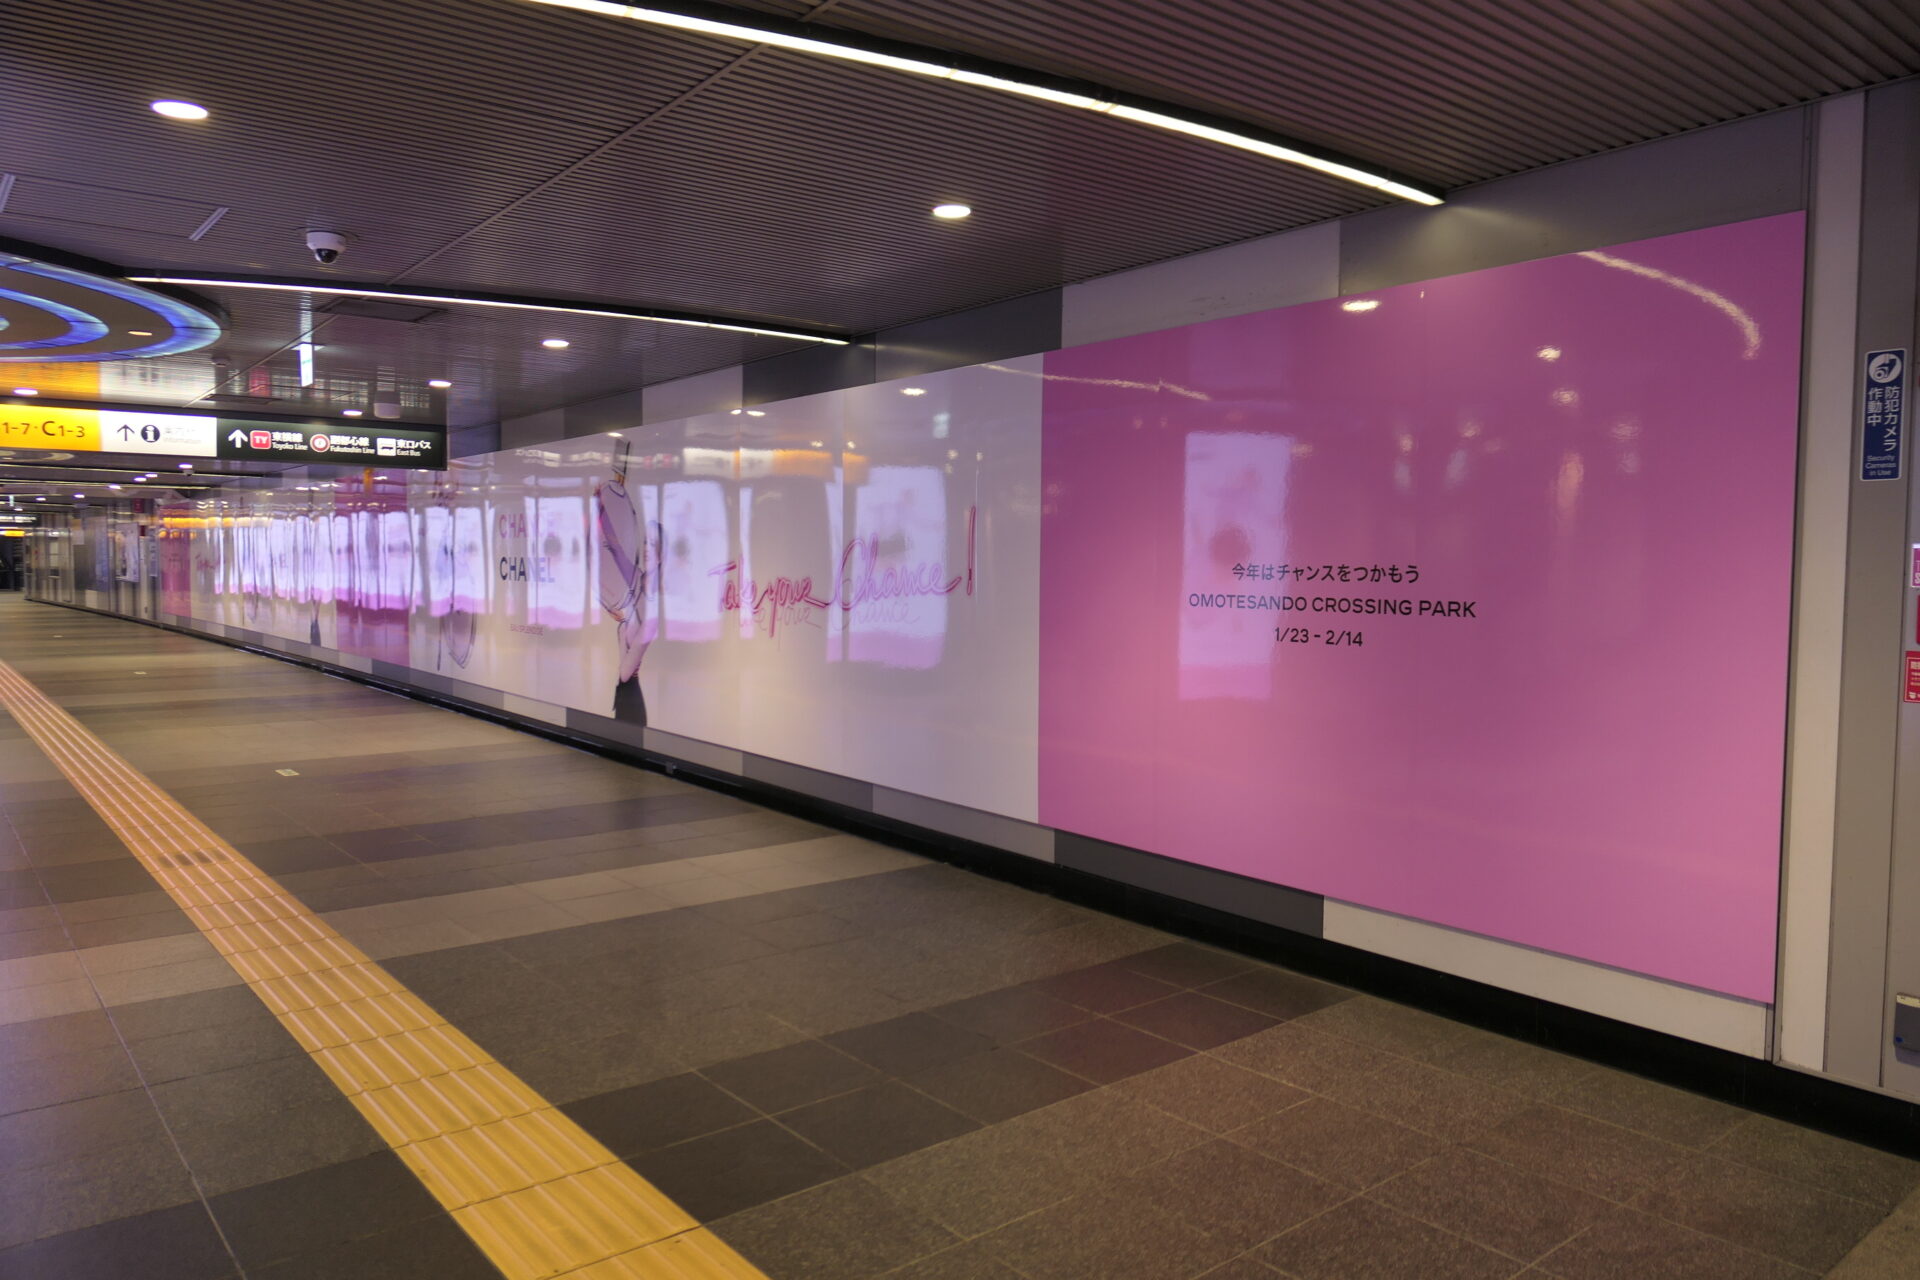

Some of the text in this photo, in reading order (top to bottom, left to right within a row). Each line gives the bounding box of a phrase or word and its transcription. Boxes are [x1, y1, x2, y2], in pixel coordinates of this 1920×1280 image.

[1867, 387, 1883, 427] 作動中
[1883, 386, 1900, 452] 防犯カメラ
[253, 435, 269, 444] TY
[272, 442, 308, 451] Toyoko Line
[396, 439, 432, 449] 東口バス
[396, 448, 410, 456] East
[499, 555, 555, 583] CHANEL
[1231, 563, 1420, 584] 今年はチャンスをつかもう
[1189, 593, 1477, 618] OMOTESANDO CROSSING PARK
